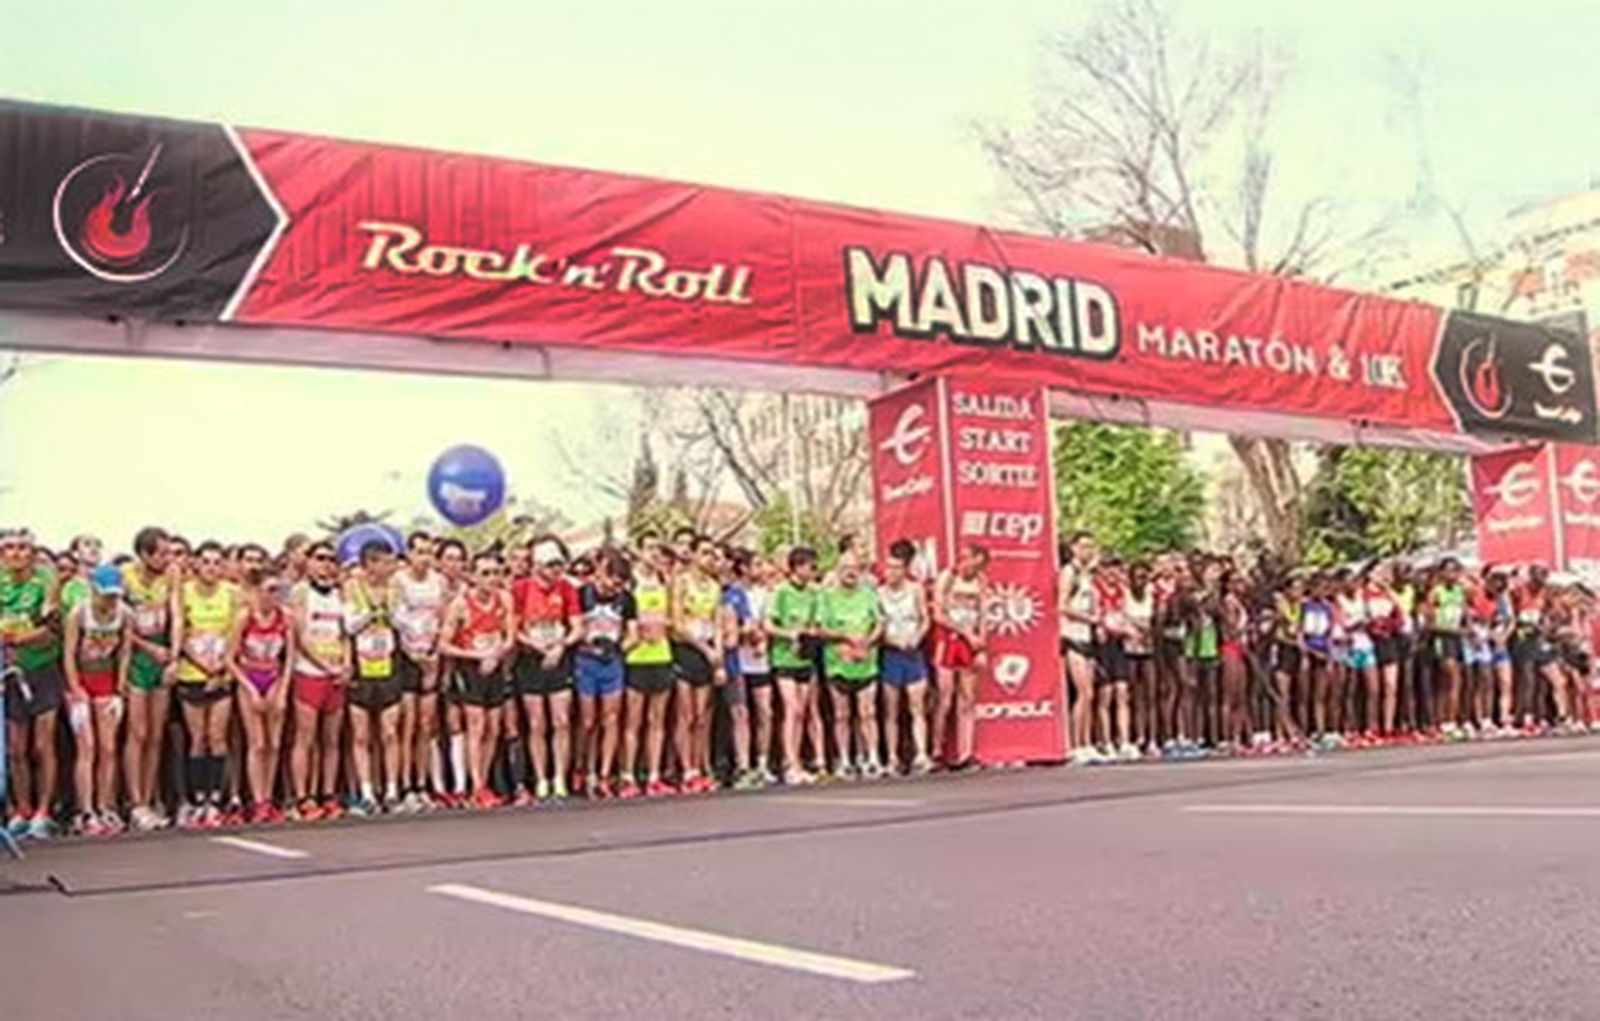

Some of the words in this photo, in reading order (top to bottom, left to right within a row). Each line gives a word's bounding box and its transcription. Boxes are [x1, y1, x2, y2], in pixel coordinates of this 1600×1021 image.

[845, 246, 1119, 359] MADRID
[1137, 322, 1316, 375] MARATÓN
[1327, 344, 1350, 380] &
[958, 427, 1031, 453] START
